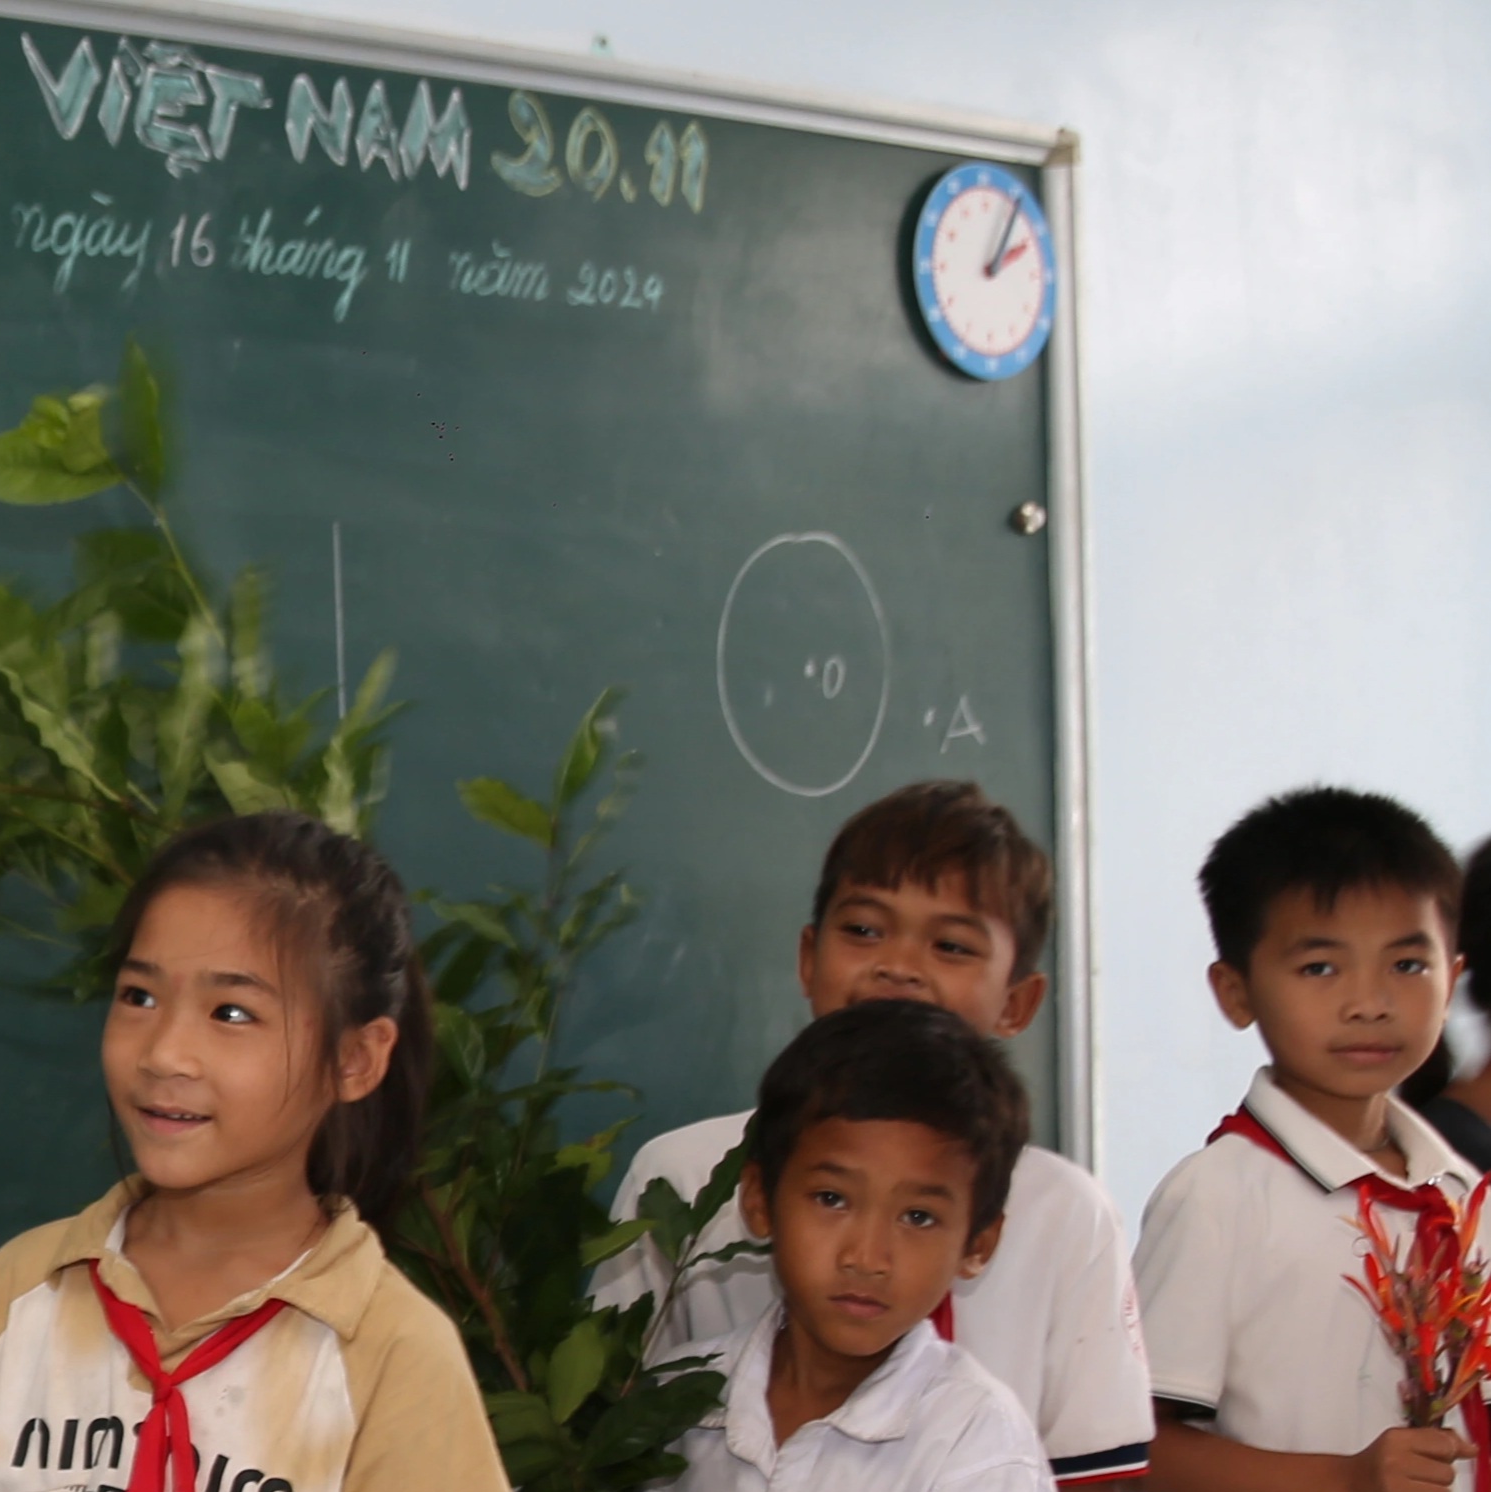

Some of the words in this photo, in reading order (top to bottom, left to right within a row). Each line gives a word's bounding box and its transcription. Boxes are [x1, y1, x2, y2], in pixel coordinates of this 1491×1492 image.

[20, 32, 273, 180] VIỆT
[285, 74, 472, 190] NAM
[491, 90, 709, 213] 20.11
[15, 189, 153, 294] ngày
[170, 212, 217, 268] 16
[230, 205, 369, 323] tháng
[385, 237, 412, 283] 11
